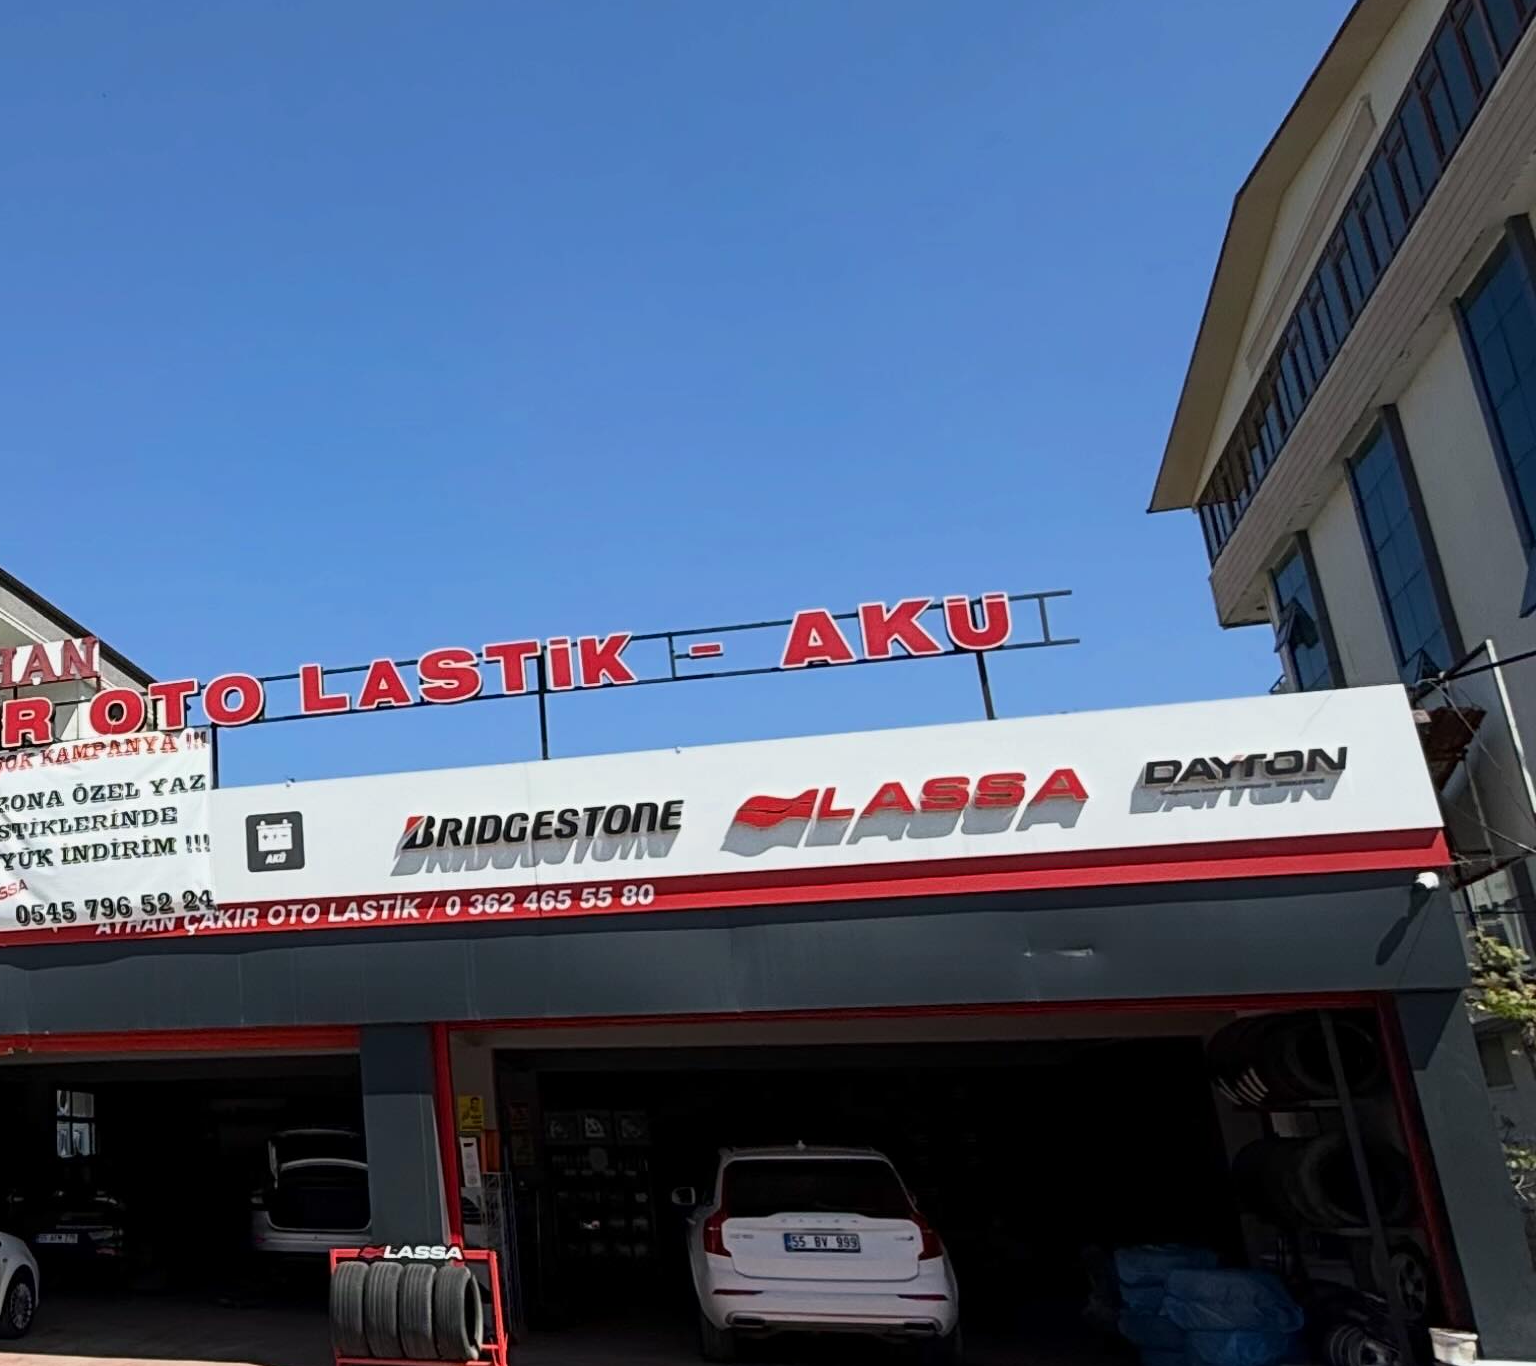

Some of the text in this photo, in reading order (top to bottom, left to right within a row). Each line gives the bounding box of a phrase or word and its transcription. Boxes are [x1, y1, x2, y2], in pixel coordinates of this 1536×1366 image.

[88, 674, 264, 736] OTO
[298, 633, 637, 715] LASTİK
[40, 734, 177, 767] KAMPANYA
[1144, 746, 1348, 785] DAYTON
[72, 782, 140, 805] ÖZEL
[150, 773, 206, 795] YAZ
[817, 767, 1089, 819] LASSA
[401, 799, 684, 851] BRIDGESTONE
[15, 889, 214, 926] 0545 796 52 24
[183, 905, 258, 935] ÇAKIR
[267, 903, 321, 925] OTO
[328, 894, 421, 923] LASTİK
[445, 896, 461, 916] 0
[468, 892, 515, 915] 362
[523, 888, 572, 911] 465
[579, 886, 613, 908] 55
[620, 883, 655, 906] 80
[384, 1245, 463, 1260] LASSA
[791, 1236, 858, 1248] 55 BV 999
